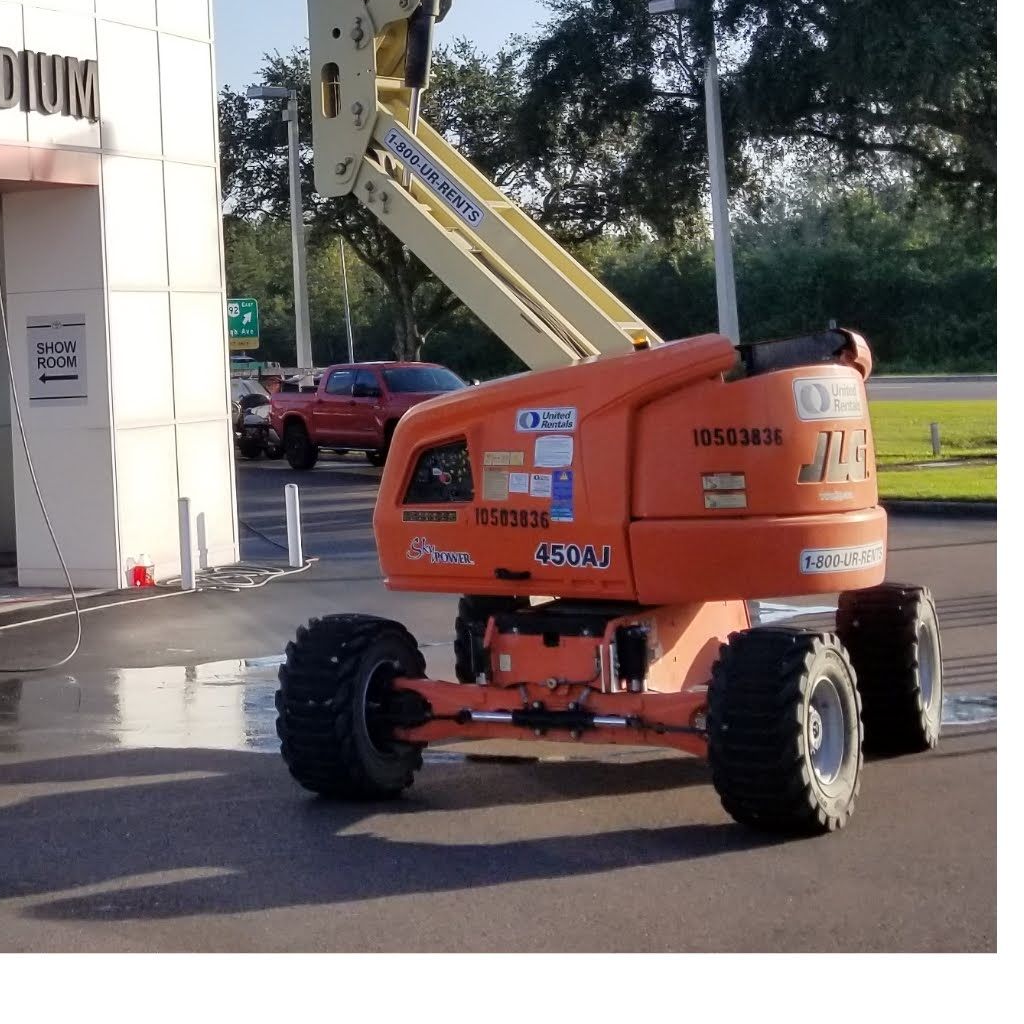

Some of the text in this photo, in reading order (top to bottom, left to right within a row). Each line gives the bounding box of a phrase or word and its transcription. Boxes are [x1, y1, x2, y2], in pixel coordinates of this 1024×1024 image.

[387, 133, 481, 223] 1-800-UR-RENTS
[36, 340, 77, 355] SHOW
[37, 355, 78, 370] ROOM
[541, 419, 573, 430] Rentals
[542, 410, 572, 421] United
[693, 427, 784, 447] 10503836
[797, 429, 868, 484] JLG
[475, 507, 550, 529] 10503836
[534, 542, 612, 569] 450AJ
